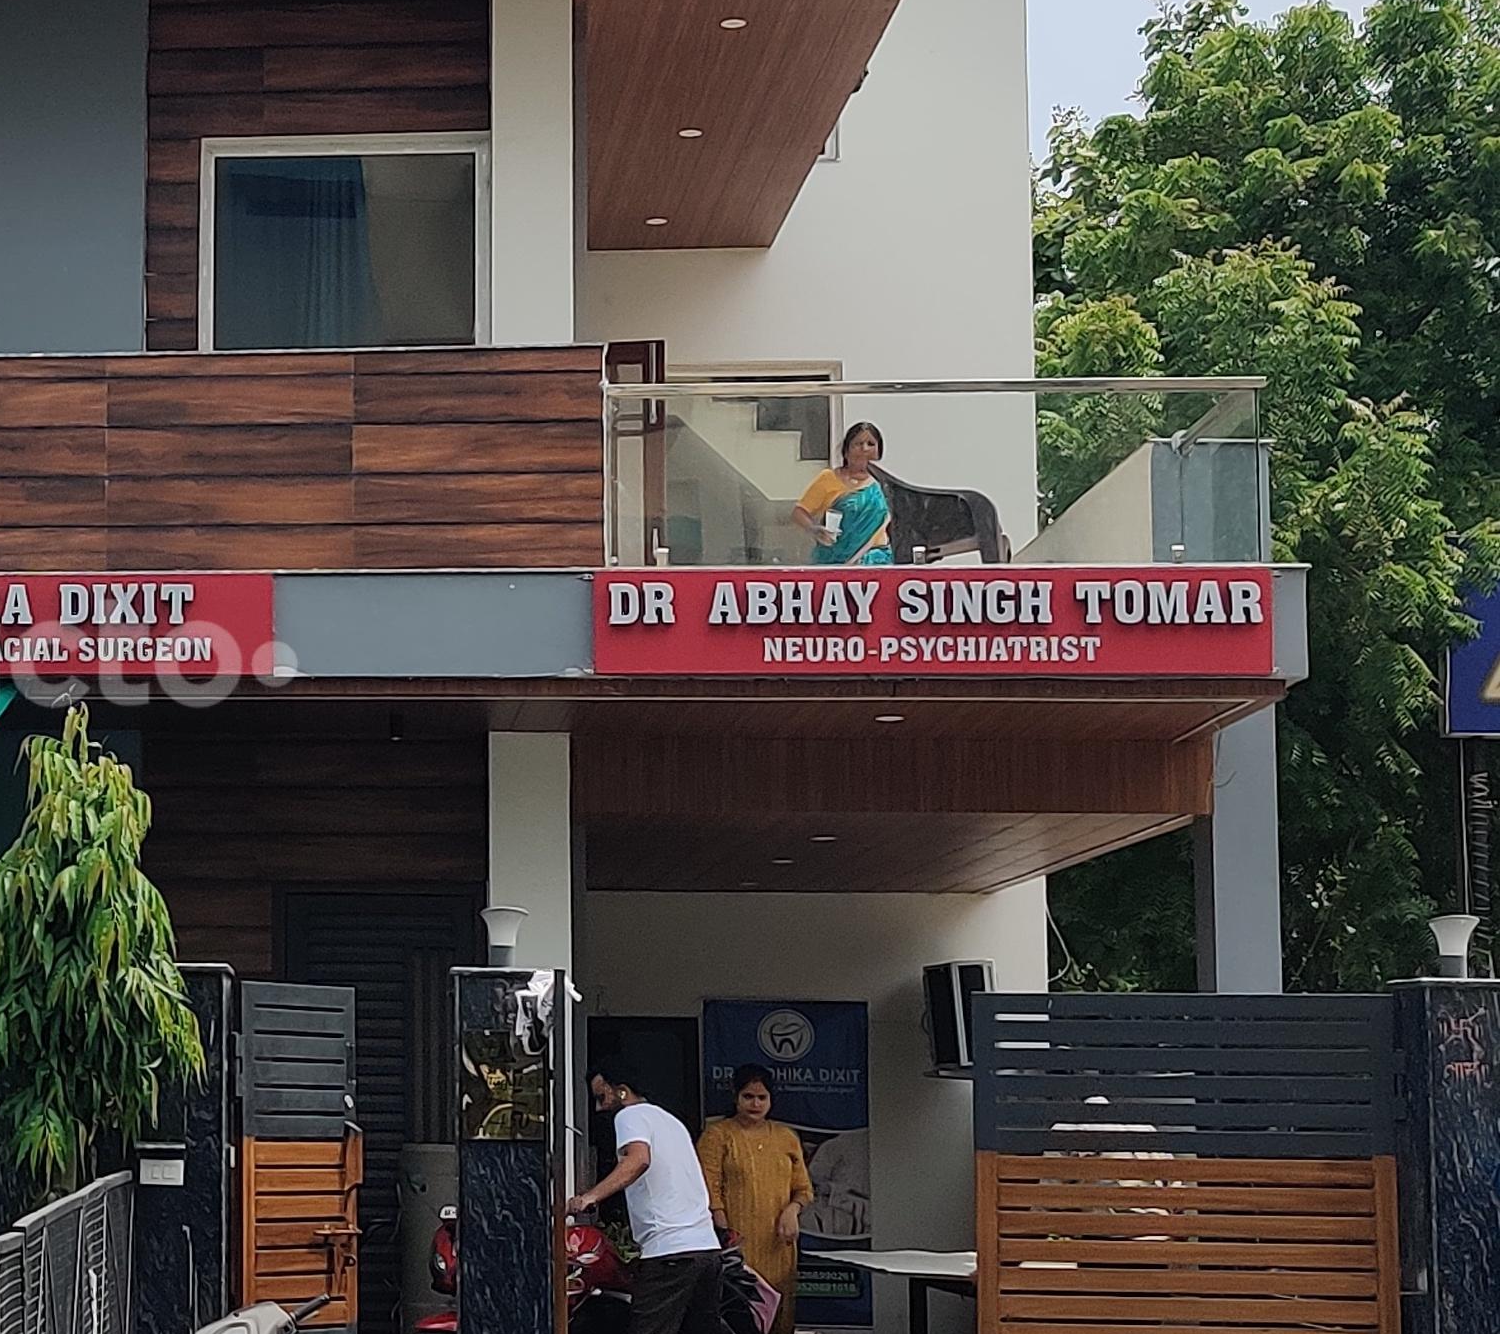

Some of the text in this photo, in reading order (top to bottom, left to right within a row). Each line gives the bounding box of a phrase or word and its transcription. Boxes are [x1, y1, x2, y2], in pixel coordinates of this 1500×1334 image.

[59, 583, 193, 625] DIXIT
[608, 579, 1264, 626] DR ABHAY SINGH TOMAR
[77, 637, 212, 663] SURGEON
[762, 636, 1101, 663] NEURO-PSYCHIATRIST
[819, 1068, 861, 1083] DIXIT
